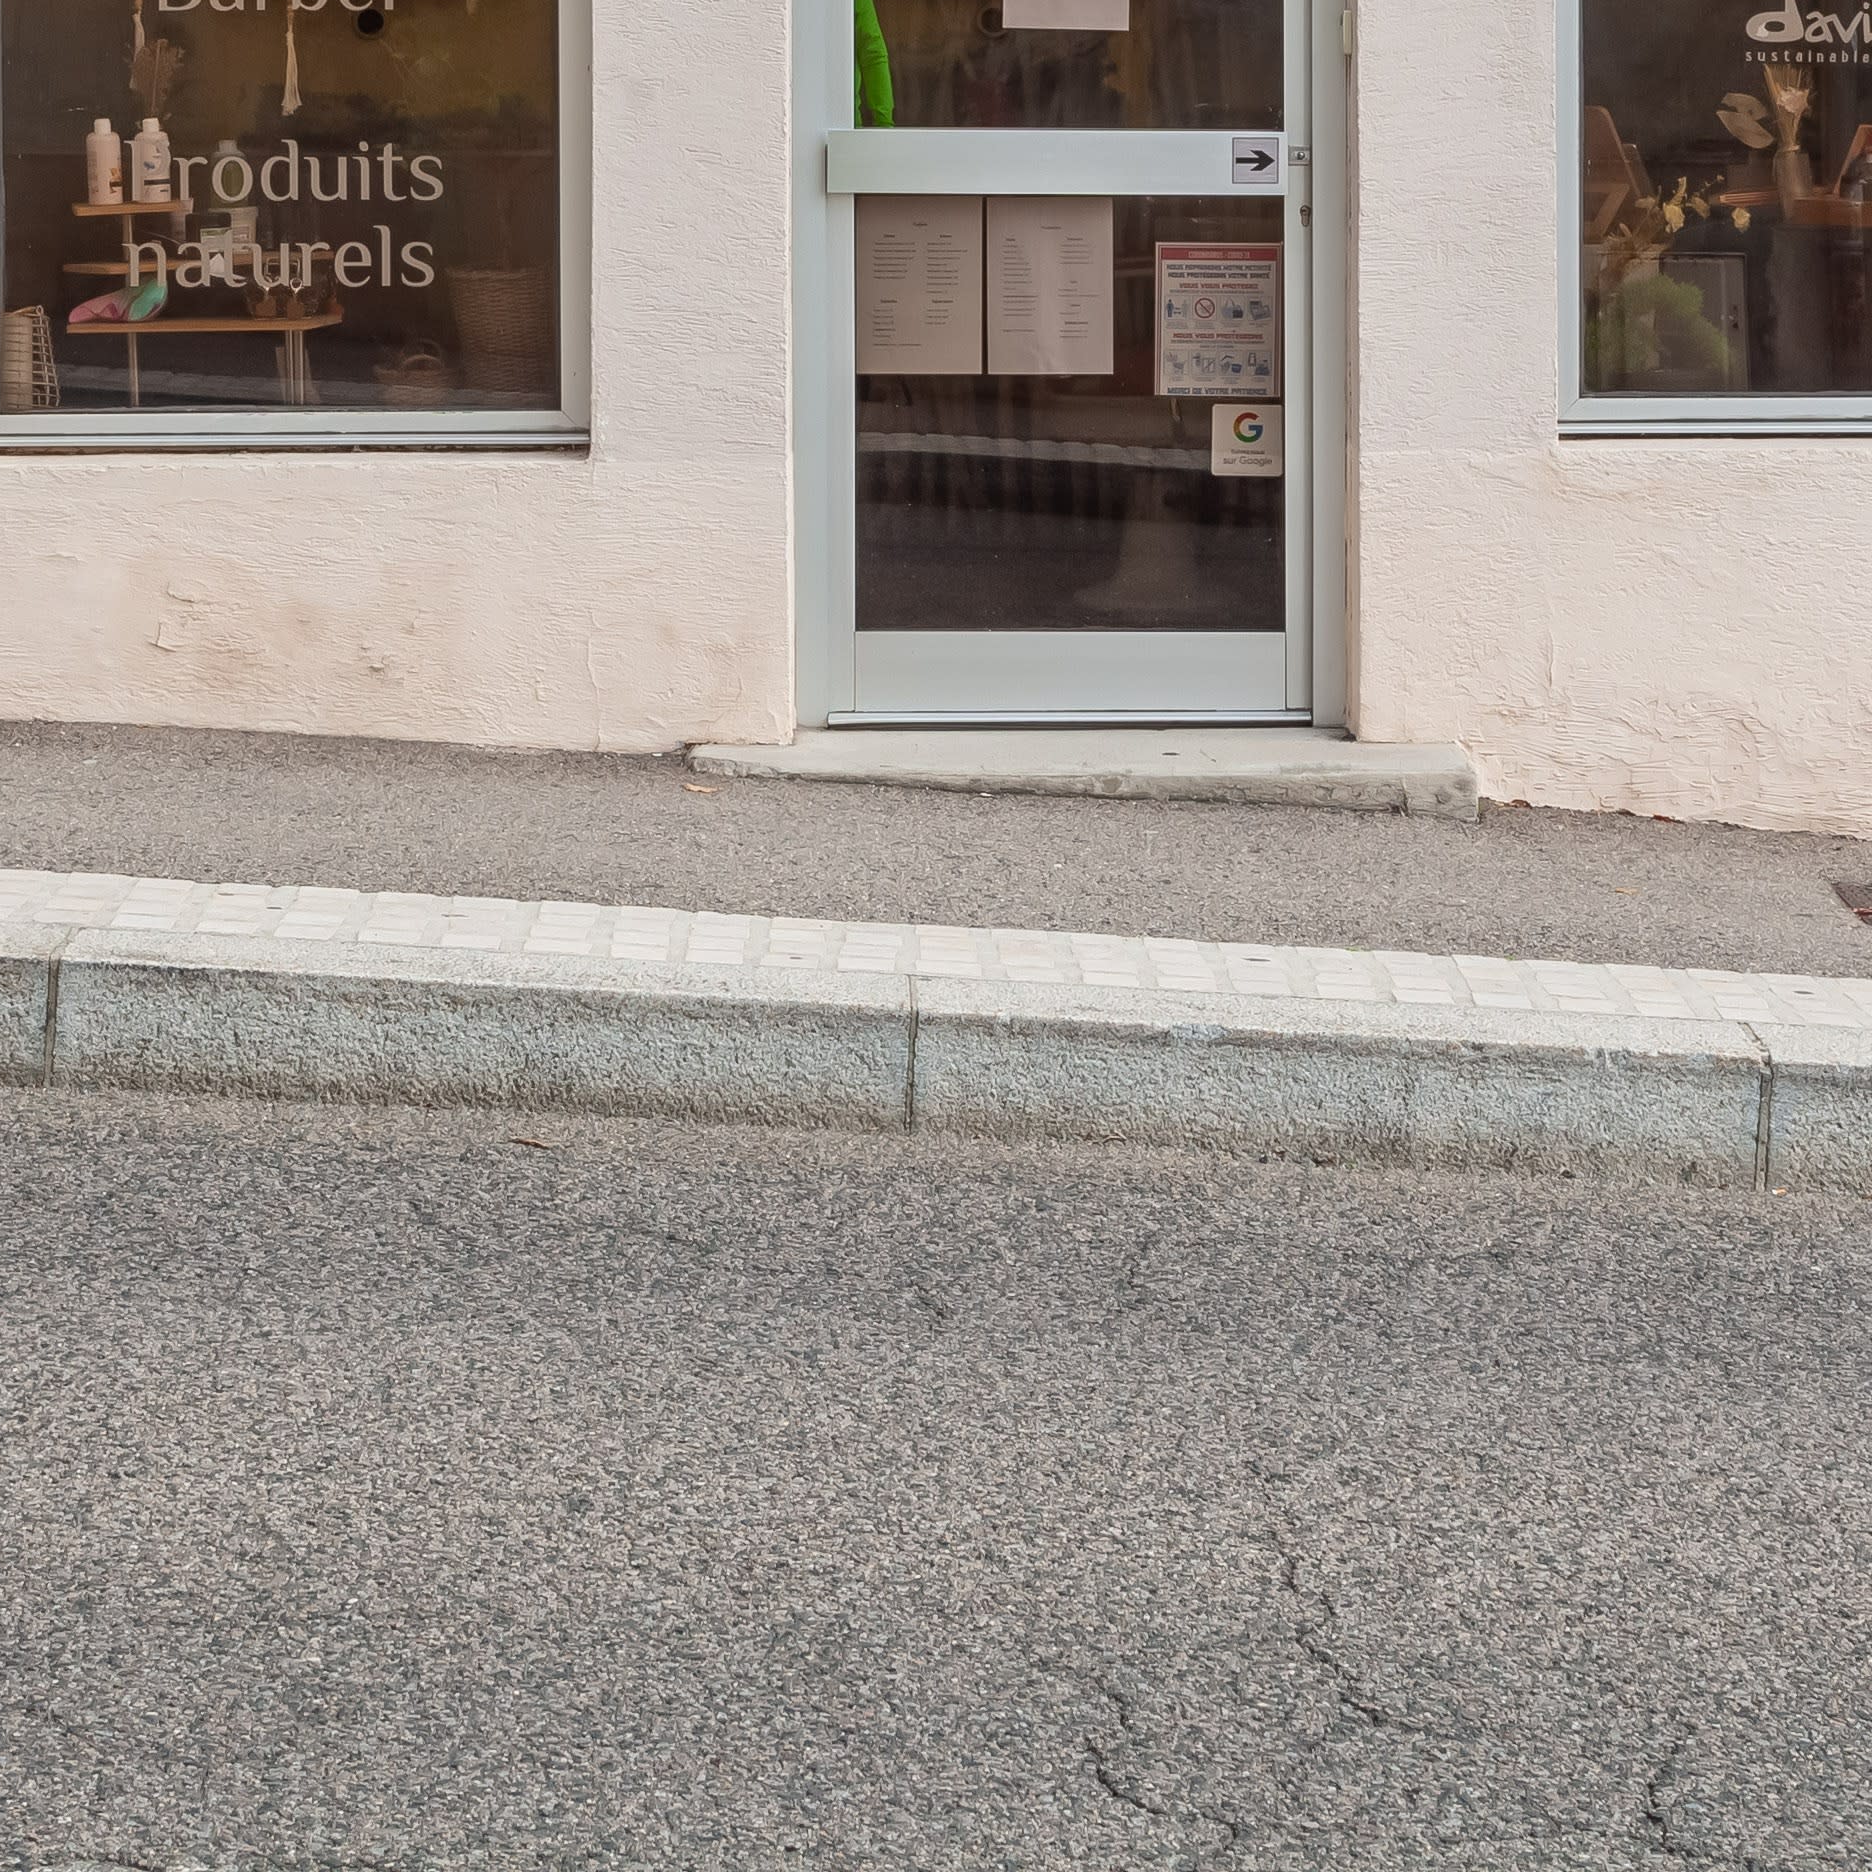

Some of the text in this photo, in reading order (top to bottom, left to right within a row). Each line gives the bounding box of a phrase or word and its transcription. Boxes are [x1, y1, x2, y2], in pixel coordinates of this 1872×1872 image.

[1745, 49, 1870, 64] sustainable
[124, 138, 445, 202] Produits
[120, 224, 436, 290] naturels
[1238, 455, 1273, 467] Google
